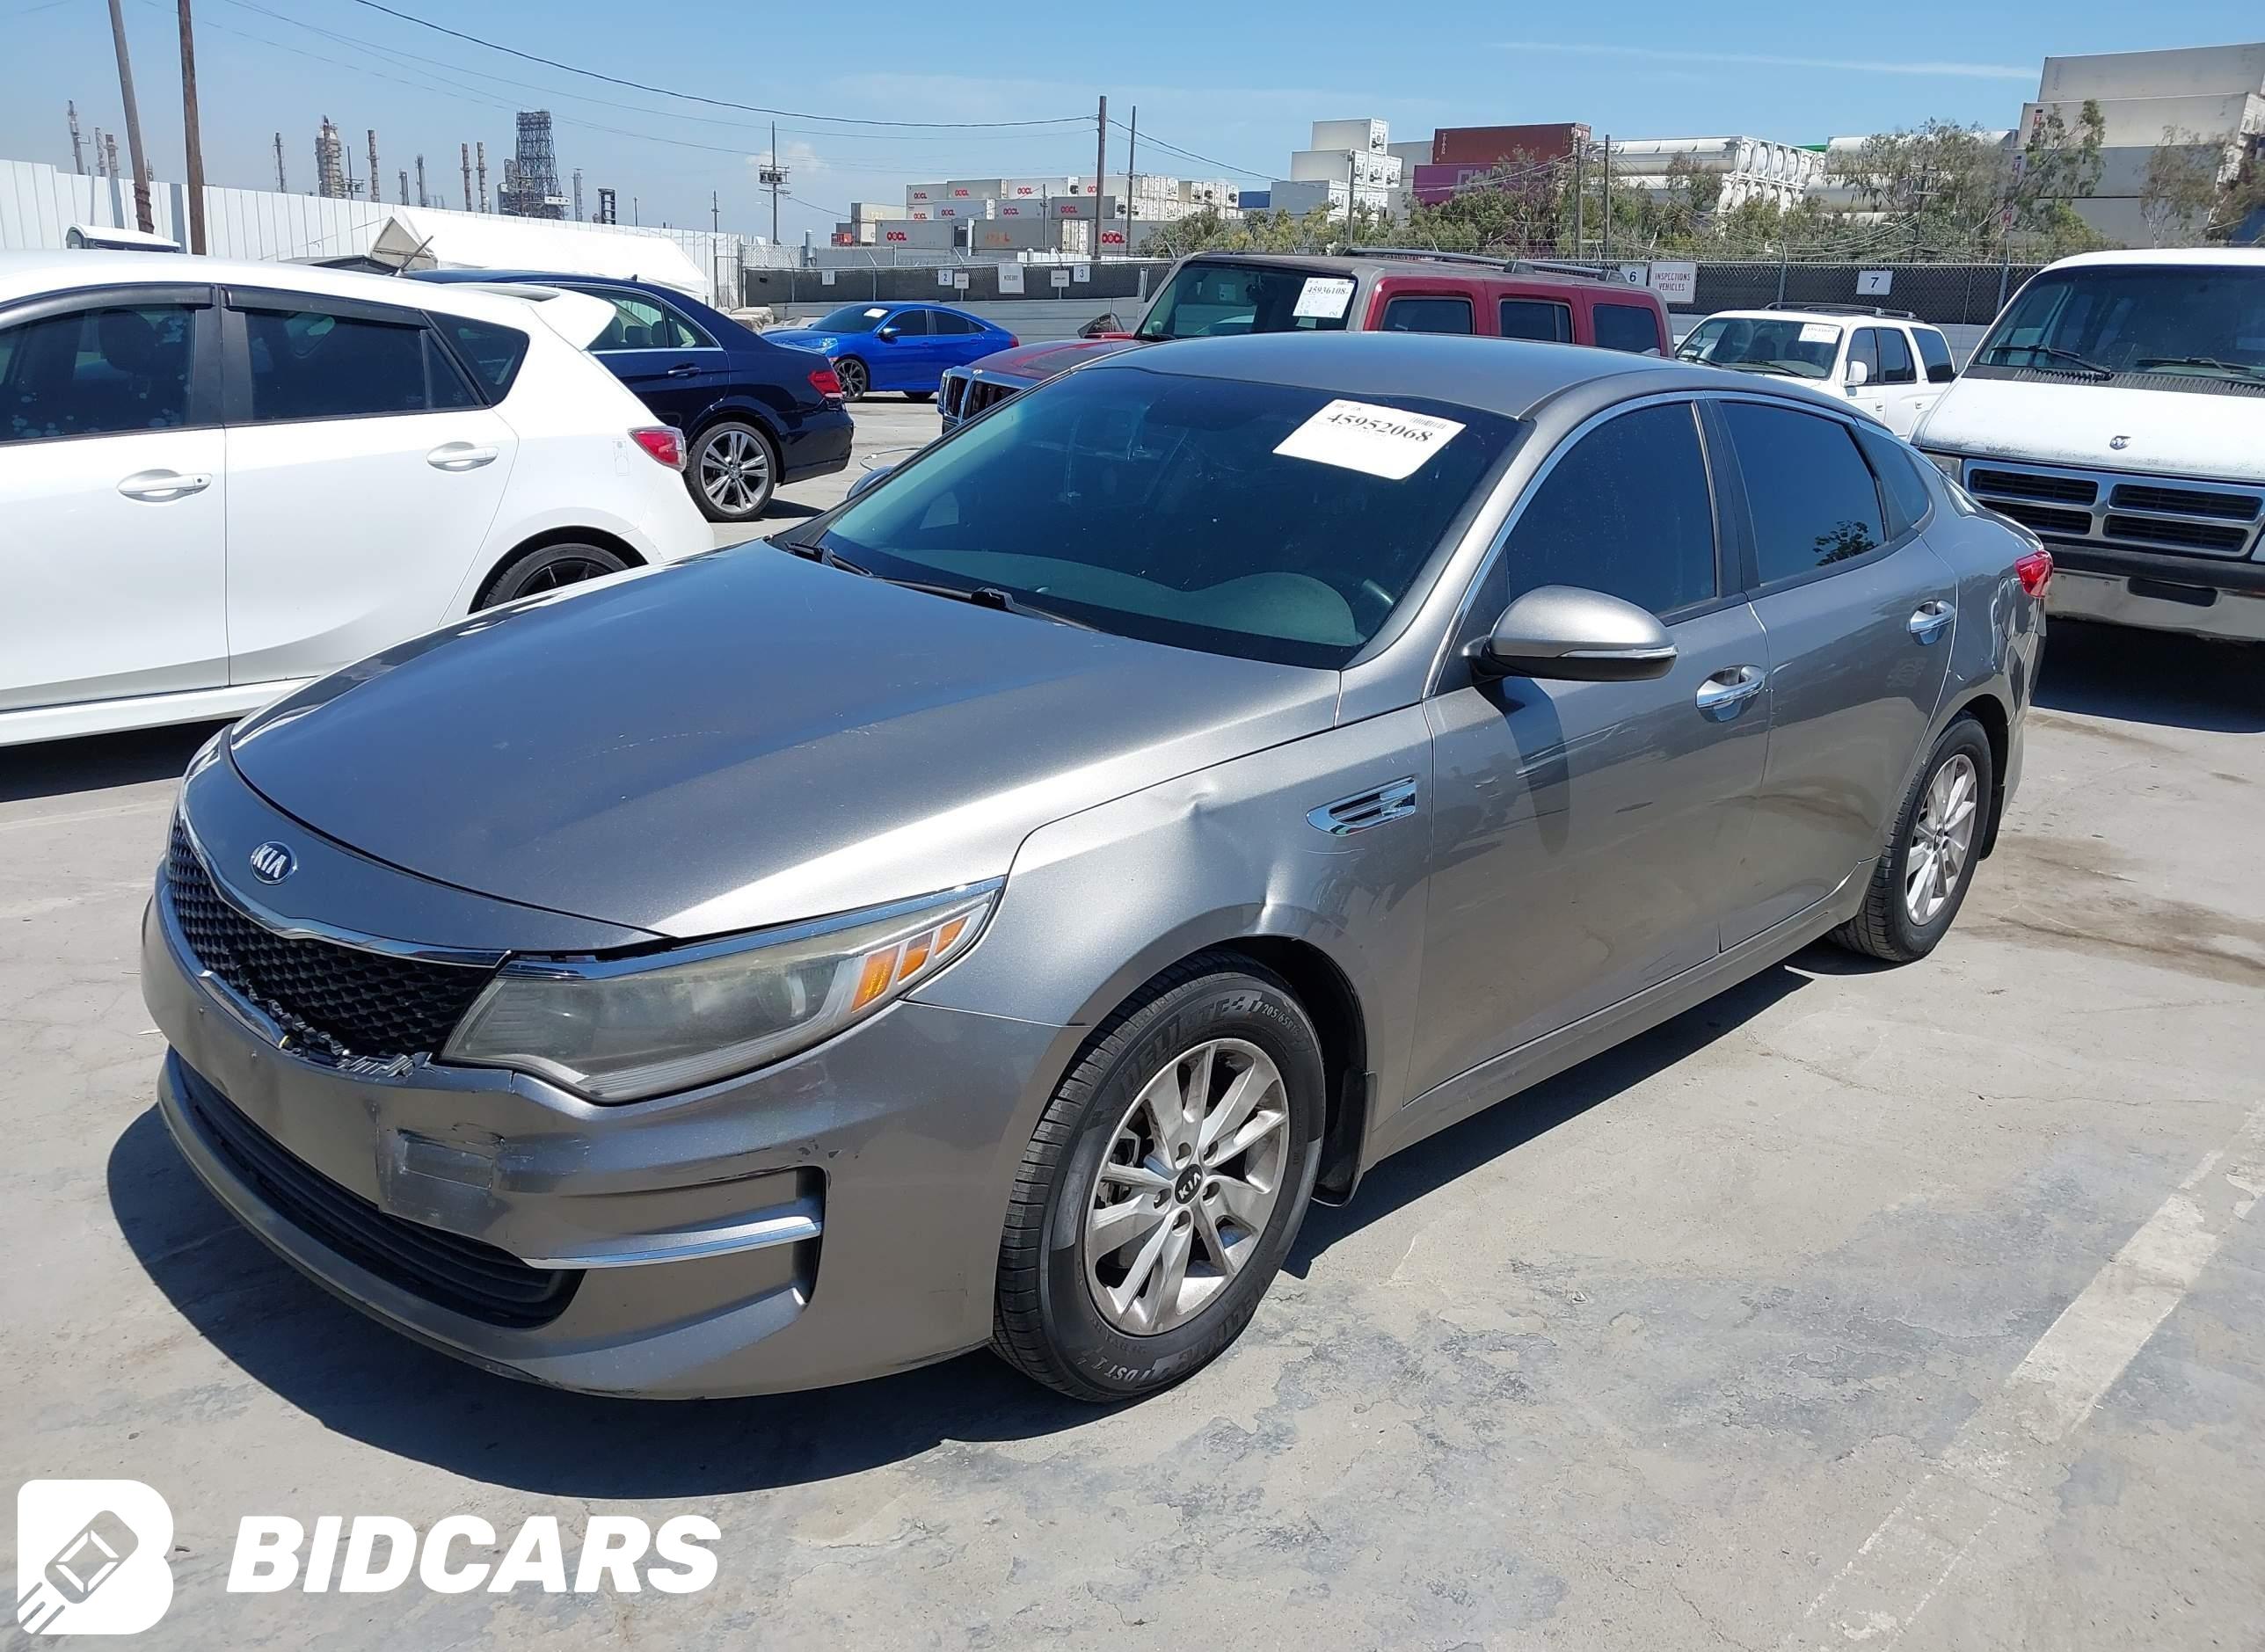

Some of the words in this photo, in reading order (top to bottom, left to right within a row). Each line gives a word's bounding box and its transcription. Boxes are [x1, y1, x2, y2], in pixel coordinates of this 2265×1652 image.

[886, 231, 907, 241] OOCL
[1101, 233, 1125, 244] OOCL
[1079, 269, 1084, 279] 3
[1629, 271, 1637, 282] 6
[1655, 272, 1691, 281] INSPECTIONS
[1658, 282, 1686, 292] VEHICLES
[1869, 276, 1880, 288] 7
[1326, 413, 1433, 443] 45952068
[252, 845, 288, 878] KIA
[1178, 1172, 1201, 1200] KIA
